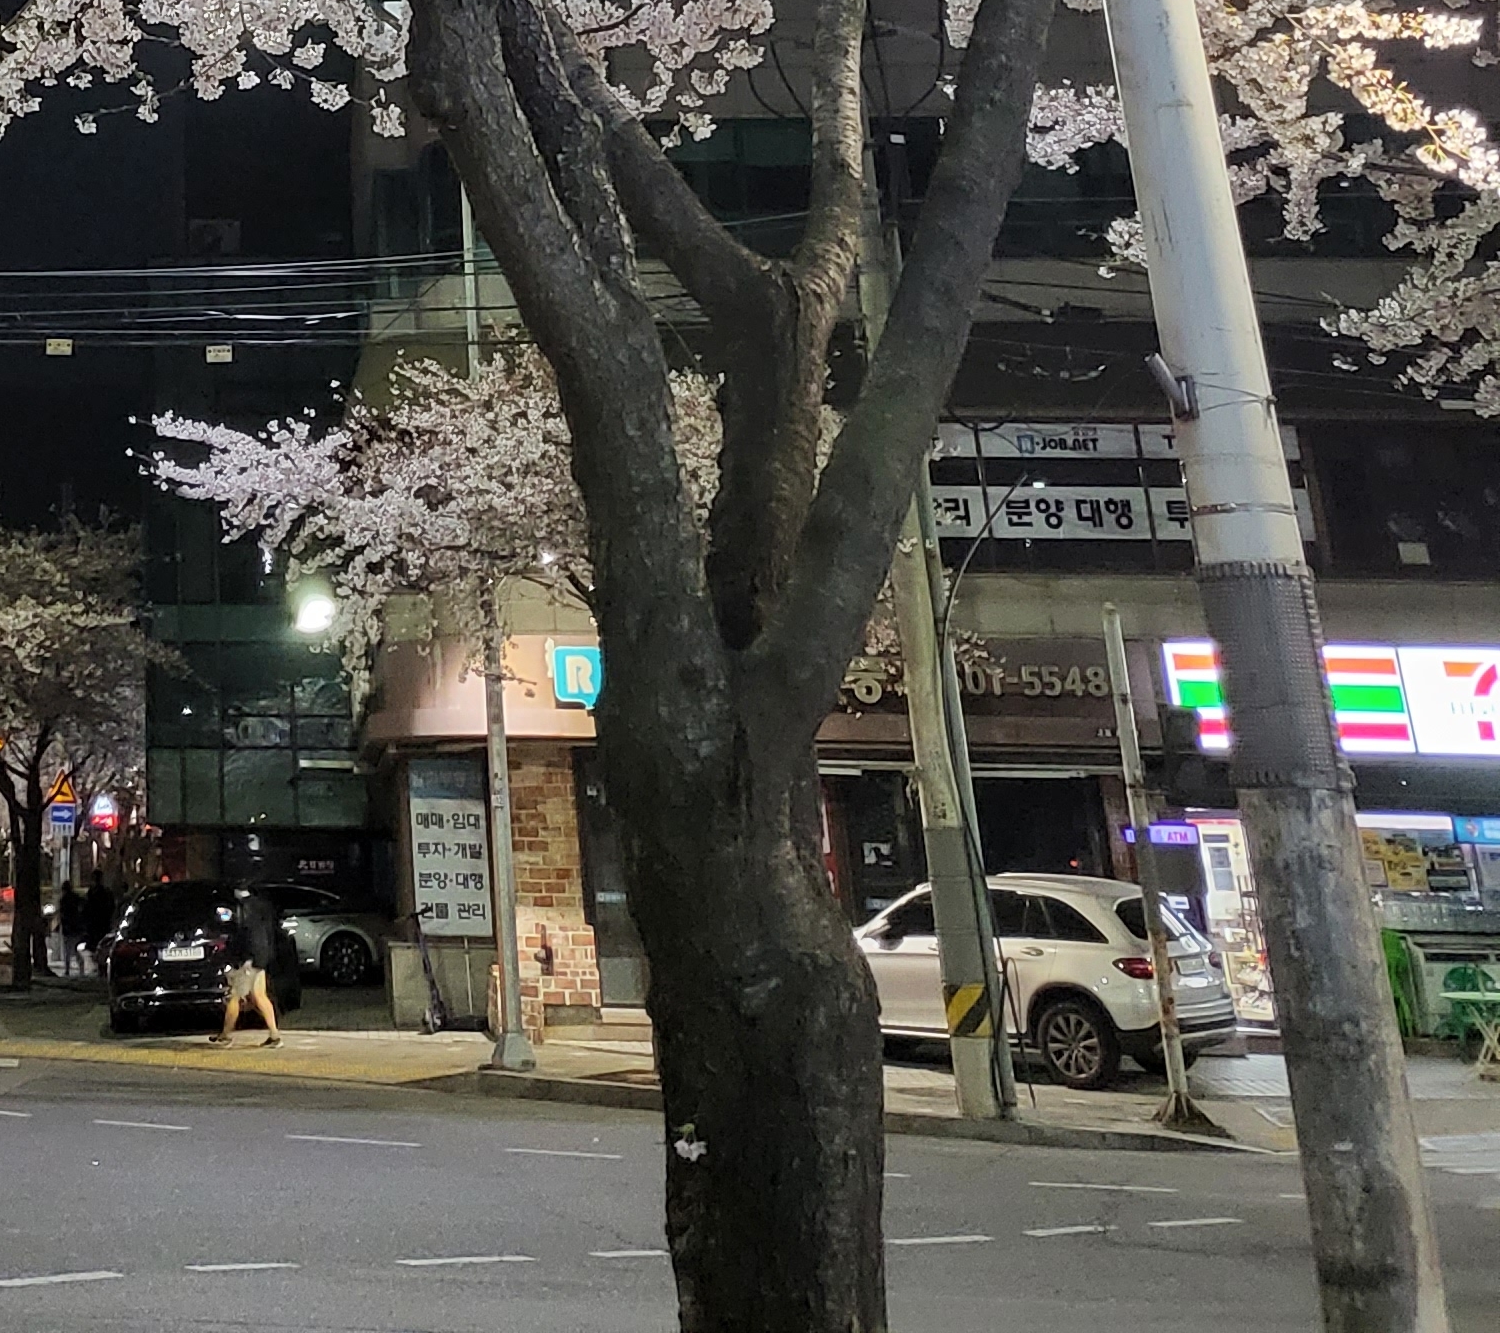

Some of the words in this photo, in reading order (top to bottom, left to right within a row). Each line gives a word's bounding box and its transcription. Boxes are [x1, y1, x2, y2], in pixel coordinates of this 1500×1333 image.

[1004, 497, 1064, 530] 분양
[1074, 497, 1134, 530] 대행
[1165, 499, 1190, 529] 투
[565, 655, 595, 694] R
[957, 664, 1110, 697] 01-5548
[1167, 831, 1189, 842] ATM
[456, 901, 487, 921] 관리
